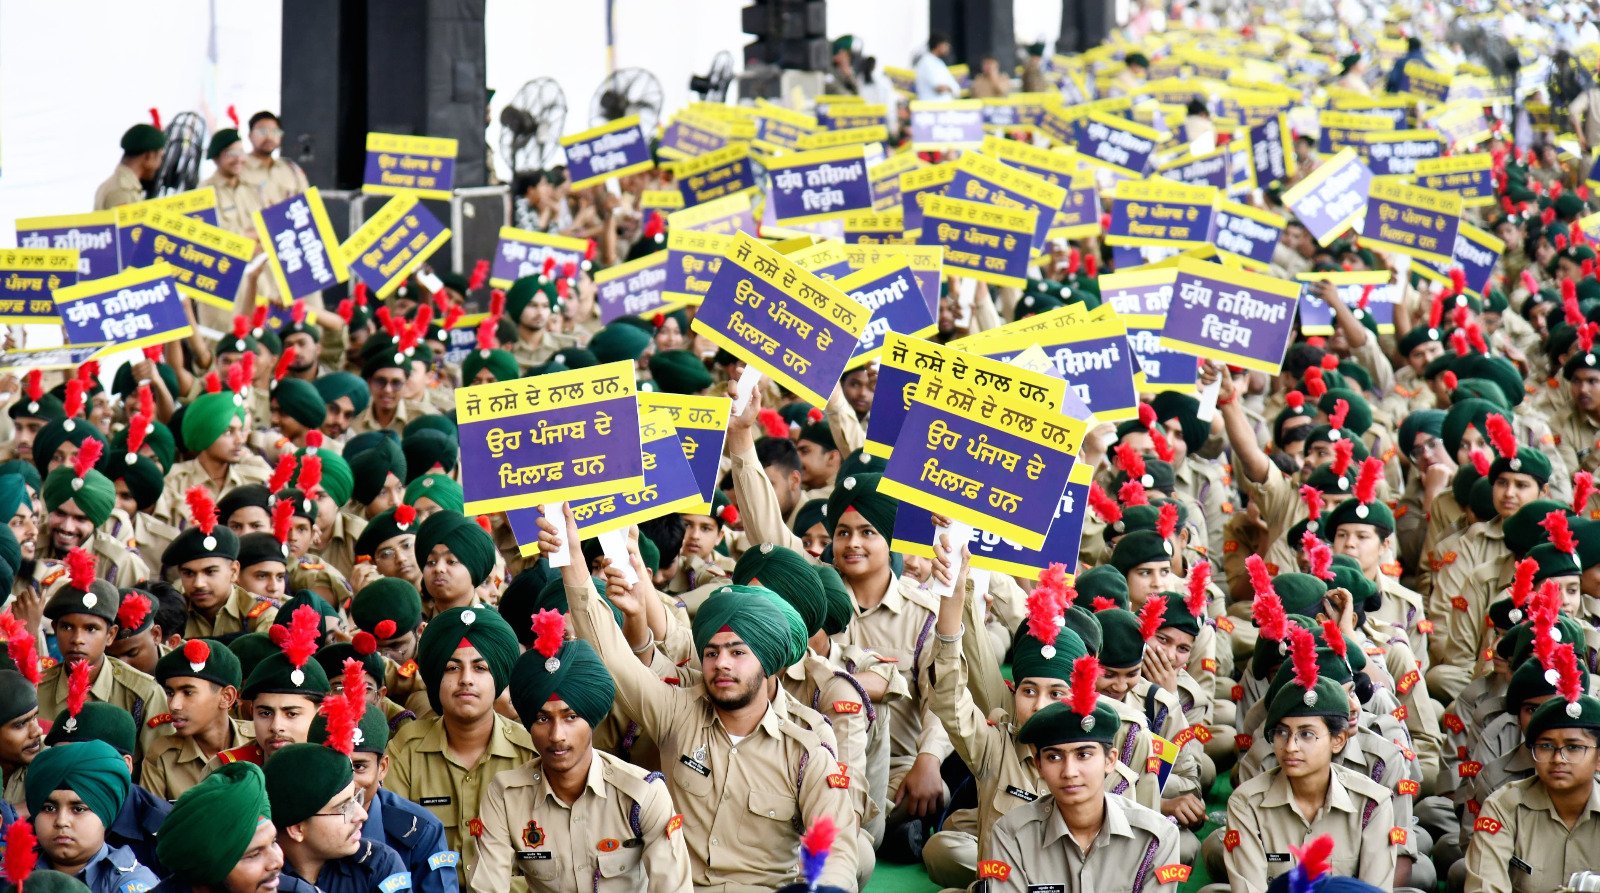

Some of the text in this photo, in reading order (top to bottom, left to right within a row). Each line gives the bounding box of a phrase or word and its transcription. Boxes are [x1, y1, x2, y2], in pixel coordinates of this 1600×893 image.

[737, 240, 859, 334] ਜੋ ਨਸ਼ੇ ਦੇ ਨਾਲ ਹਨ,
[1180, 280, 1212, 309] ਯੁੱਧ
[734, 278, 765, 309] ਉਹ
[770, 300, 814, 339] ਪੰਜਾਬ
[817, 327, 833, 351] ਦੇ
[782, 349, 811, 376] ਹਨ
[892, 339, 1055, 409] ਜੋ ਨਸ਼ੇ ਦੇ ਨਾਲ ਹਨ,
[466, 376, 629, 416] ਜੋ ਨਸ਼ੇ ਦੇ ਨਾਲ ਹਨ,
[689, 408, 721, 427] ਹਨ,
[926, 376, 1073, 452] ਜੋ ਨਸ਼ੇ ਦੇ ਨਾਲ ਹਨ,
[486, 411, 612, 457] ਉਹ ਪੰਜਾਬ ਦੇ
[642, 421, 667, 437] ਨ,
[927, 419, 1046, 480] ਉਹ ਪੰਜਾਬ ਦੇ
[572, 454, 605, 476] ਹਨ
[572, 494, 615, 520] ਲਾਫ਼
[988, 487, 1023, 514] ਹਨ
[1401, 673, 1418, 690] NCC
[1195, 726, 1208, 739] NCC
[1446, 717, 1461, 731] NCC
[1174, 729, 1191, 746] NCC
[1462, 763, 1479, 773] NCC
[830, 777, 846, 787] NCC
[1399, 782, 1414, 792] NCC
[470, 822, 481, 834] NCC
[1477, 820, 1497, 830] NCC
[1392, 830, 1405, 841] NCC
[433, 854, 456, 865] NCC
[984, 864, 1007, 876] NCC
[1161, 868, 1187, 880] NCC
[385, 875, 406, 888] NCC
